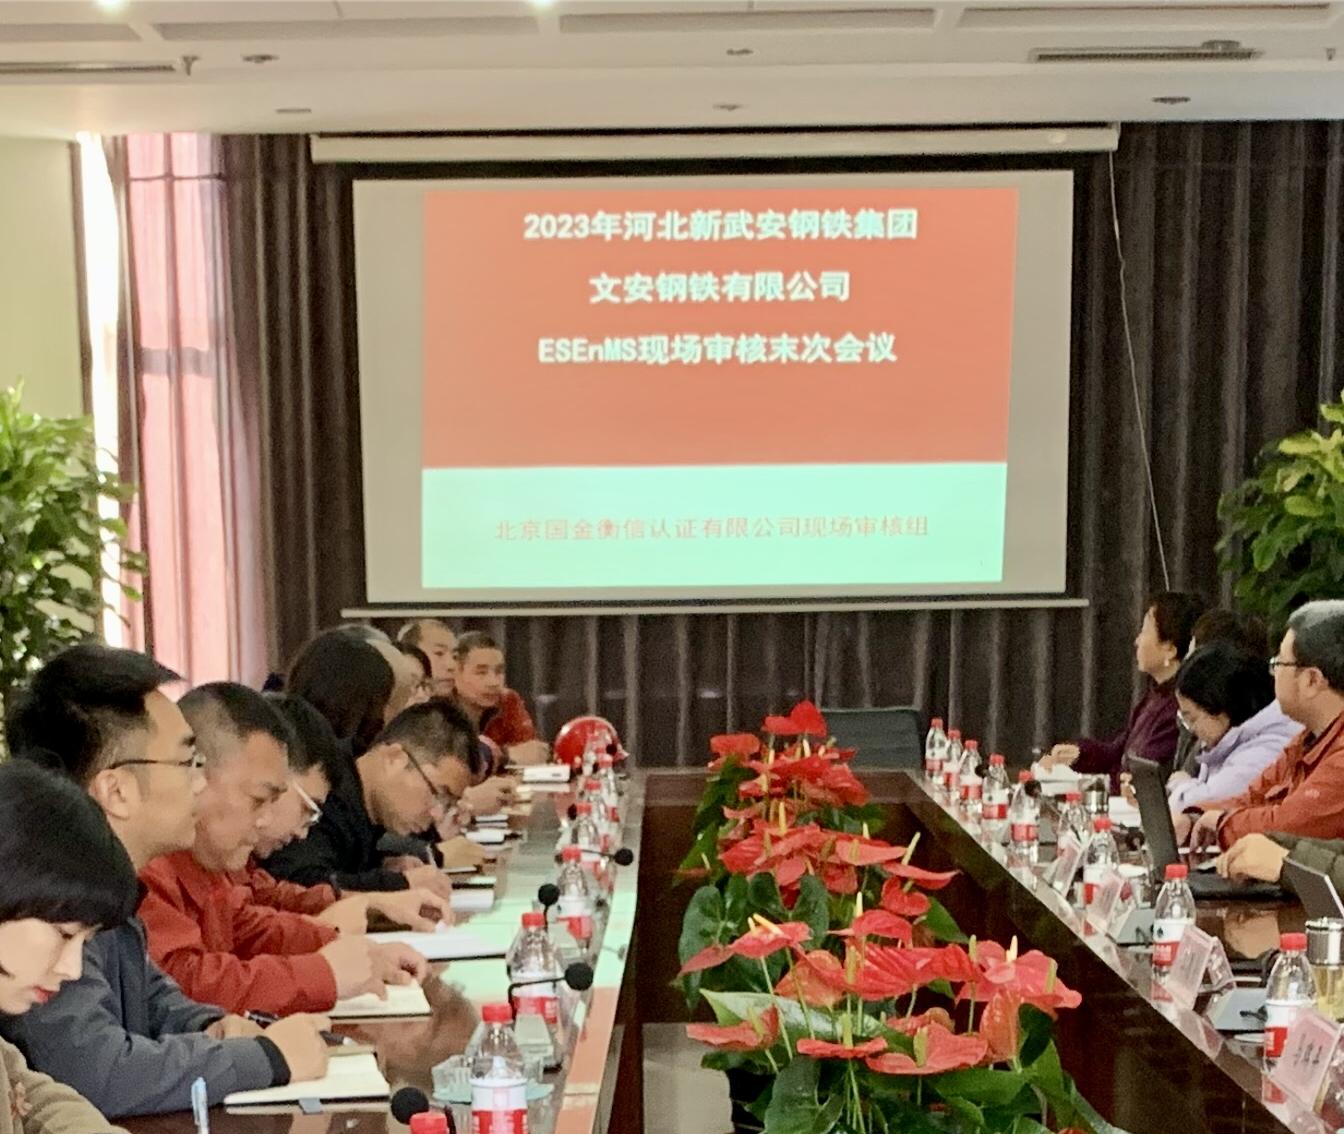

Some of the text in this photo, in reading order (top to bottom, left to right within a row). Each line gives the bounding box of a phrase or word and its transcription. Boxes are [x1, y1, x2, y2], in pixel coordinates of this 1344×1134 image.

[523, 208, 919, 241] 2023年河北新武安钢铁集团
[589, 271, 851, 304] 文安钢铁有限公司
[538, 331, 897, 364] ESEnMS现场审核末次会议
